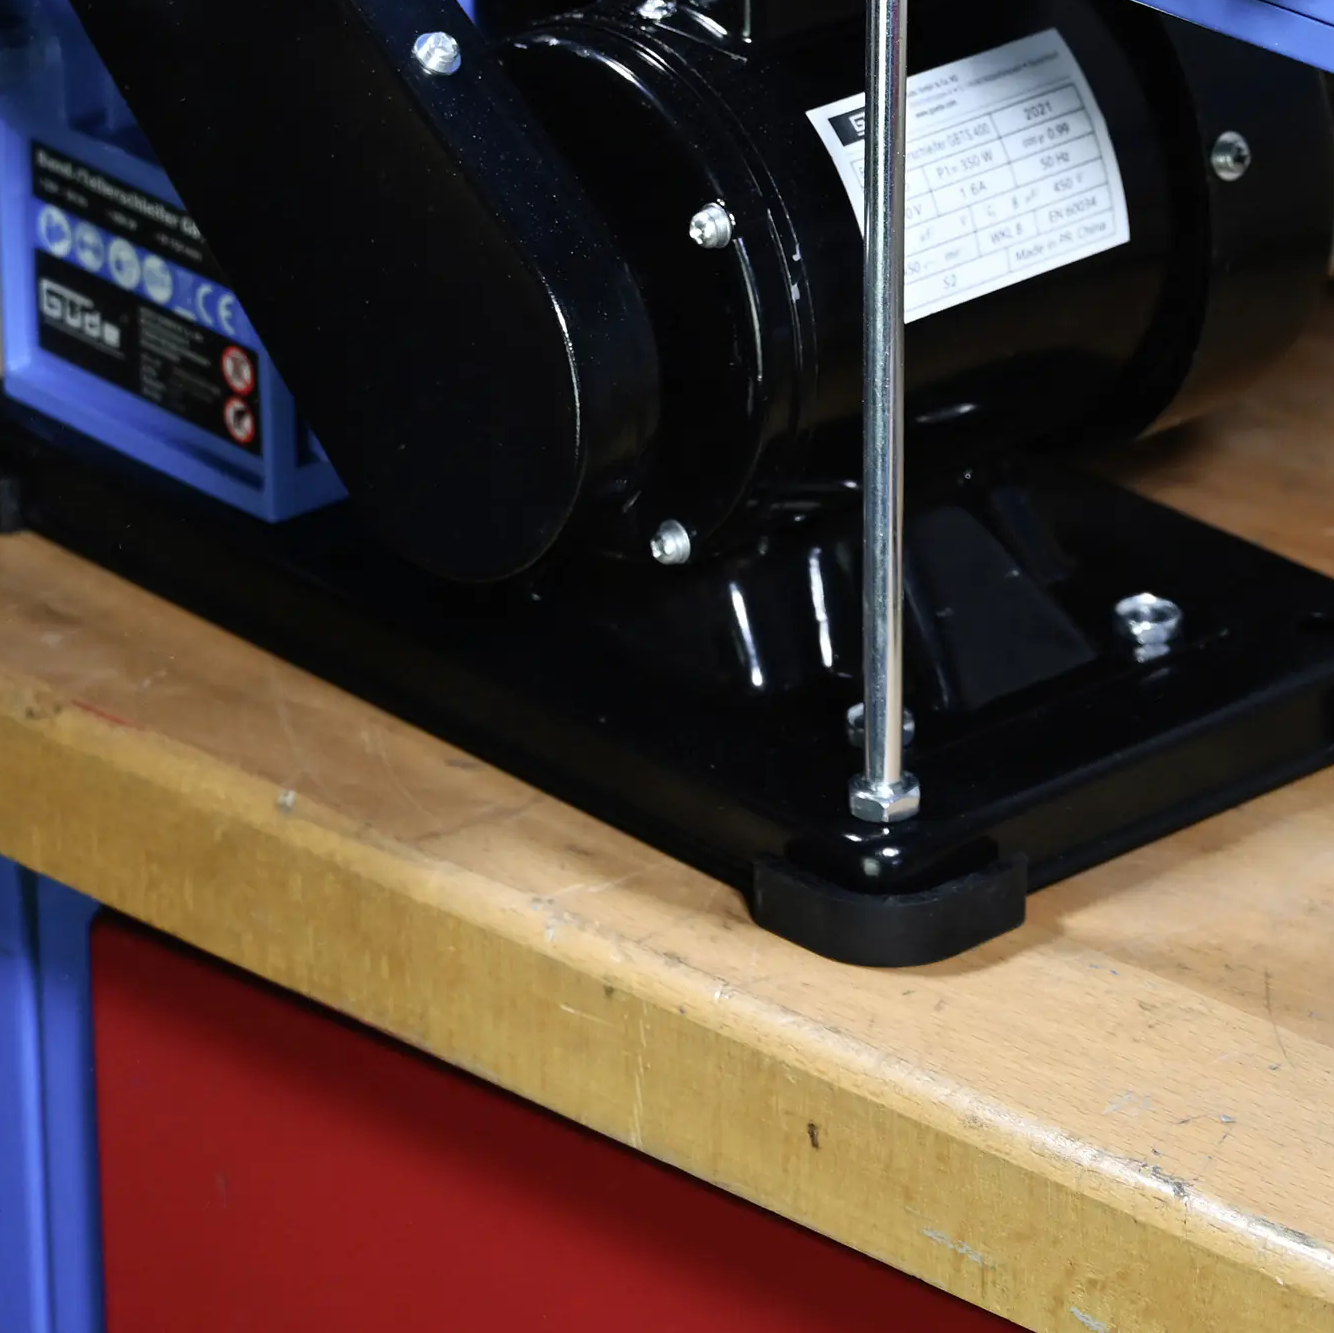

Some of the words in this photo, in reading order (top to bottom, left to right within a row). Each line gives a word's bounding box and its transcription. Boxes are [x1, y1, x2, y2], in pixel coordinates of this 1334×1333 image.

[1024, 99, 1052, 121] 2021
[948, 128, 973, 148] GBTS
[974, 122, 991, 138] 400
[960, 155, 981, 173] 350
[983, 149, 994, 163] W
[1040, 156, 1056, 171] 50
[1057, 151, 1070, 164] Hz
[1016, 241, 1044, 261] Made
[1077, 221, 1107, 240] China
